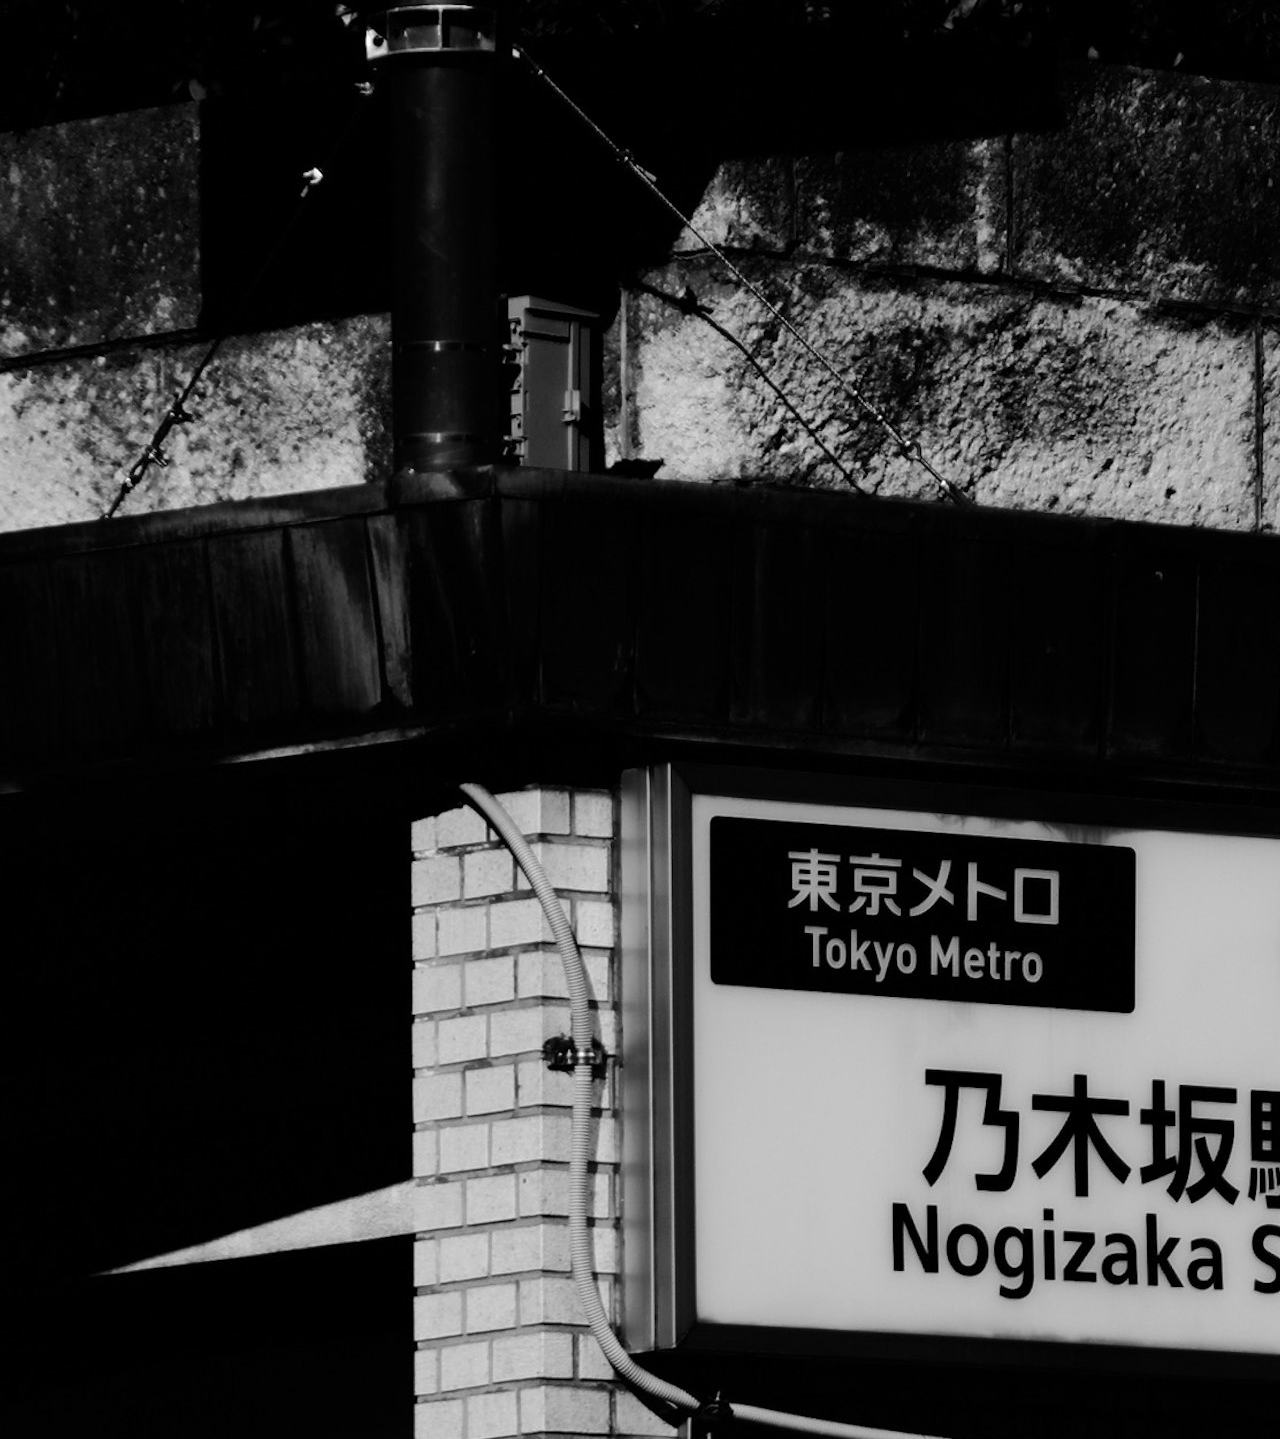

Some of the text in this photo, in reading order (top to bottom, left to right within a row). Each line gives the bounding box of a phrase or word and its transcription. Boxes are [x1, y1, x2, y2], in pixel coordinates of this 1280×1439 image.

[788, 848, 1060, 926] 東京メトロ
[804, 926, 1044, 983] Tokyo Metro
[891, 1202, 1225, 1300] Nogizaka
